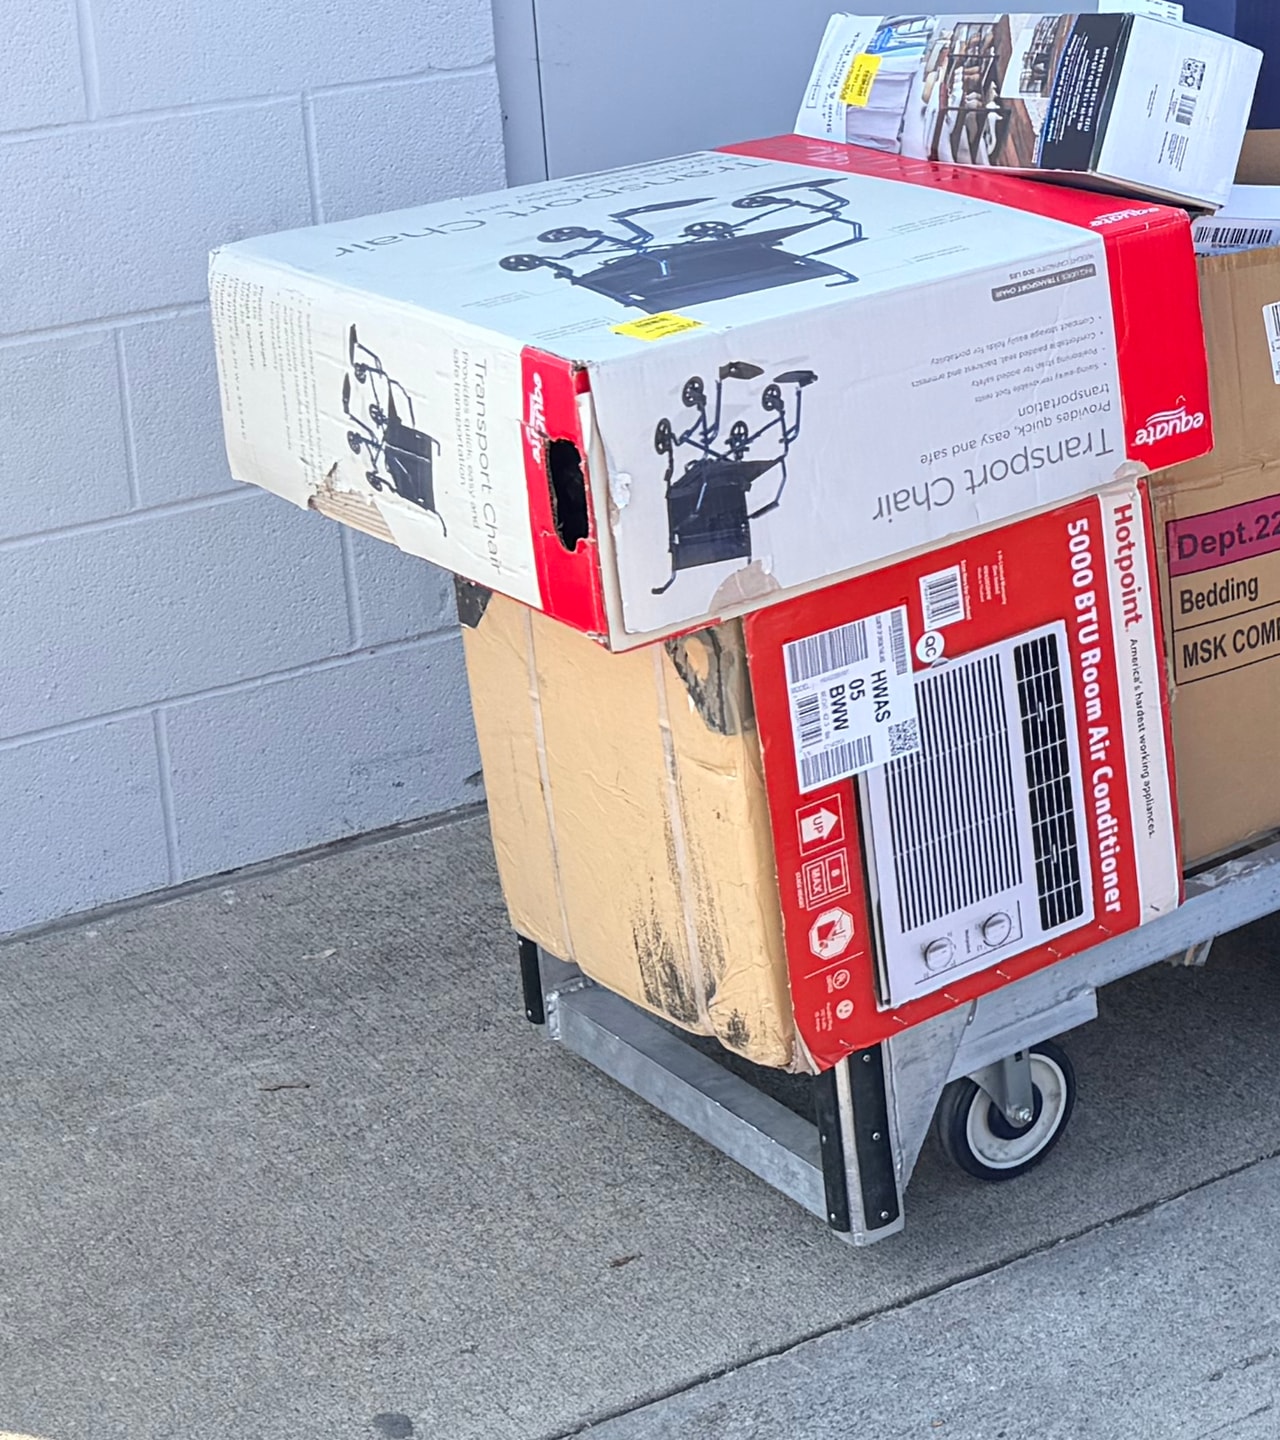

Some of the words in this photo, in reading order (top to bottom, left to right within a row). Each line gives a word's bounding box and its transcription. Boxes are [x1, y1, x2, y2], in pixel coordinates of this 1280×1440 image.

[335, 219, 487, 257] Chair
[1018, 382, 1110, 417] transportation
[1056, 400, 1111, 424] Provides
[474, 358, 494, 494] Transport
[980, 430, 1011, 447] easy
[1014, 417, 1053, 438] quick,
[1134, 409, 1206, 446] equate
[920, 449, 949, 465] safe
[952, 439, 977, 458] and
[964, 428, 1115, 495] Transport
[872, 477, 955, 523] Chair
[483, 503, 501, 575] Chair
[1067, 518, 1094, 588] 5000
[1114, 503, 1143, 631] Hotpoint
[1180, 576, 1259, 616] Bedding
[1074, 591, 1099, 645] BTU
[924, 635, 937, 656] QC
[1130, 639, 1143, 691] America's
[1182, 633, 1227, 669] MSK
[849, 678, 866, 701] 05
[871, 669, 891, 724] HWAS
[1080, 647, 1103, 721] Room
[829, 684, 849, 732] BWW
[1134, 692, 1146, 732] hardest
[1088, 726, 1110, 761] Air
[1138, 734, 1150, 778] working
[813, 815, 824, 834] UP
[1092, 765, 1121, 913] Conditioner
[811, 867, 823, 895] MAX
